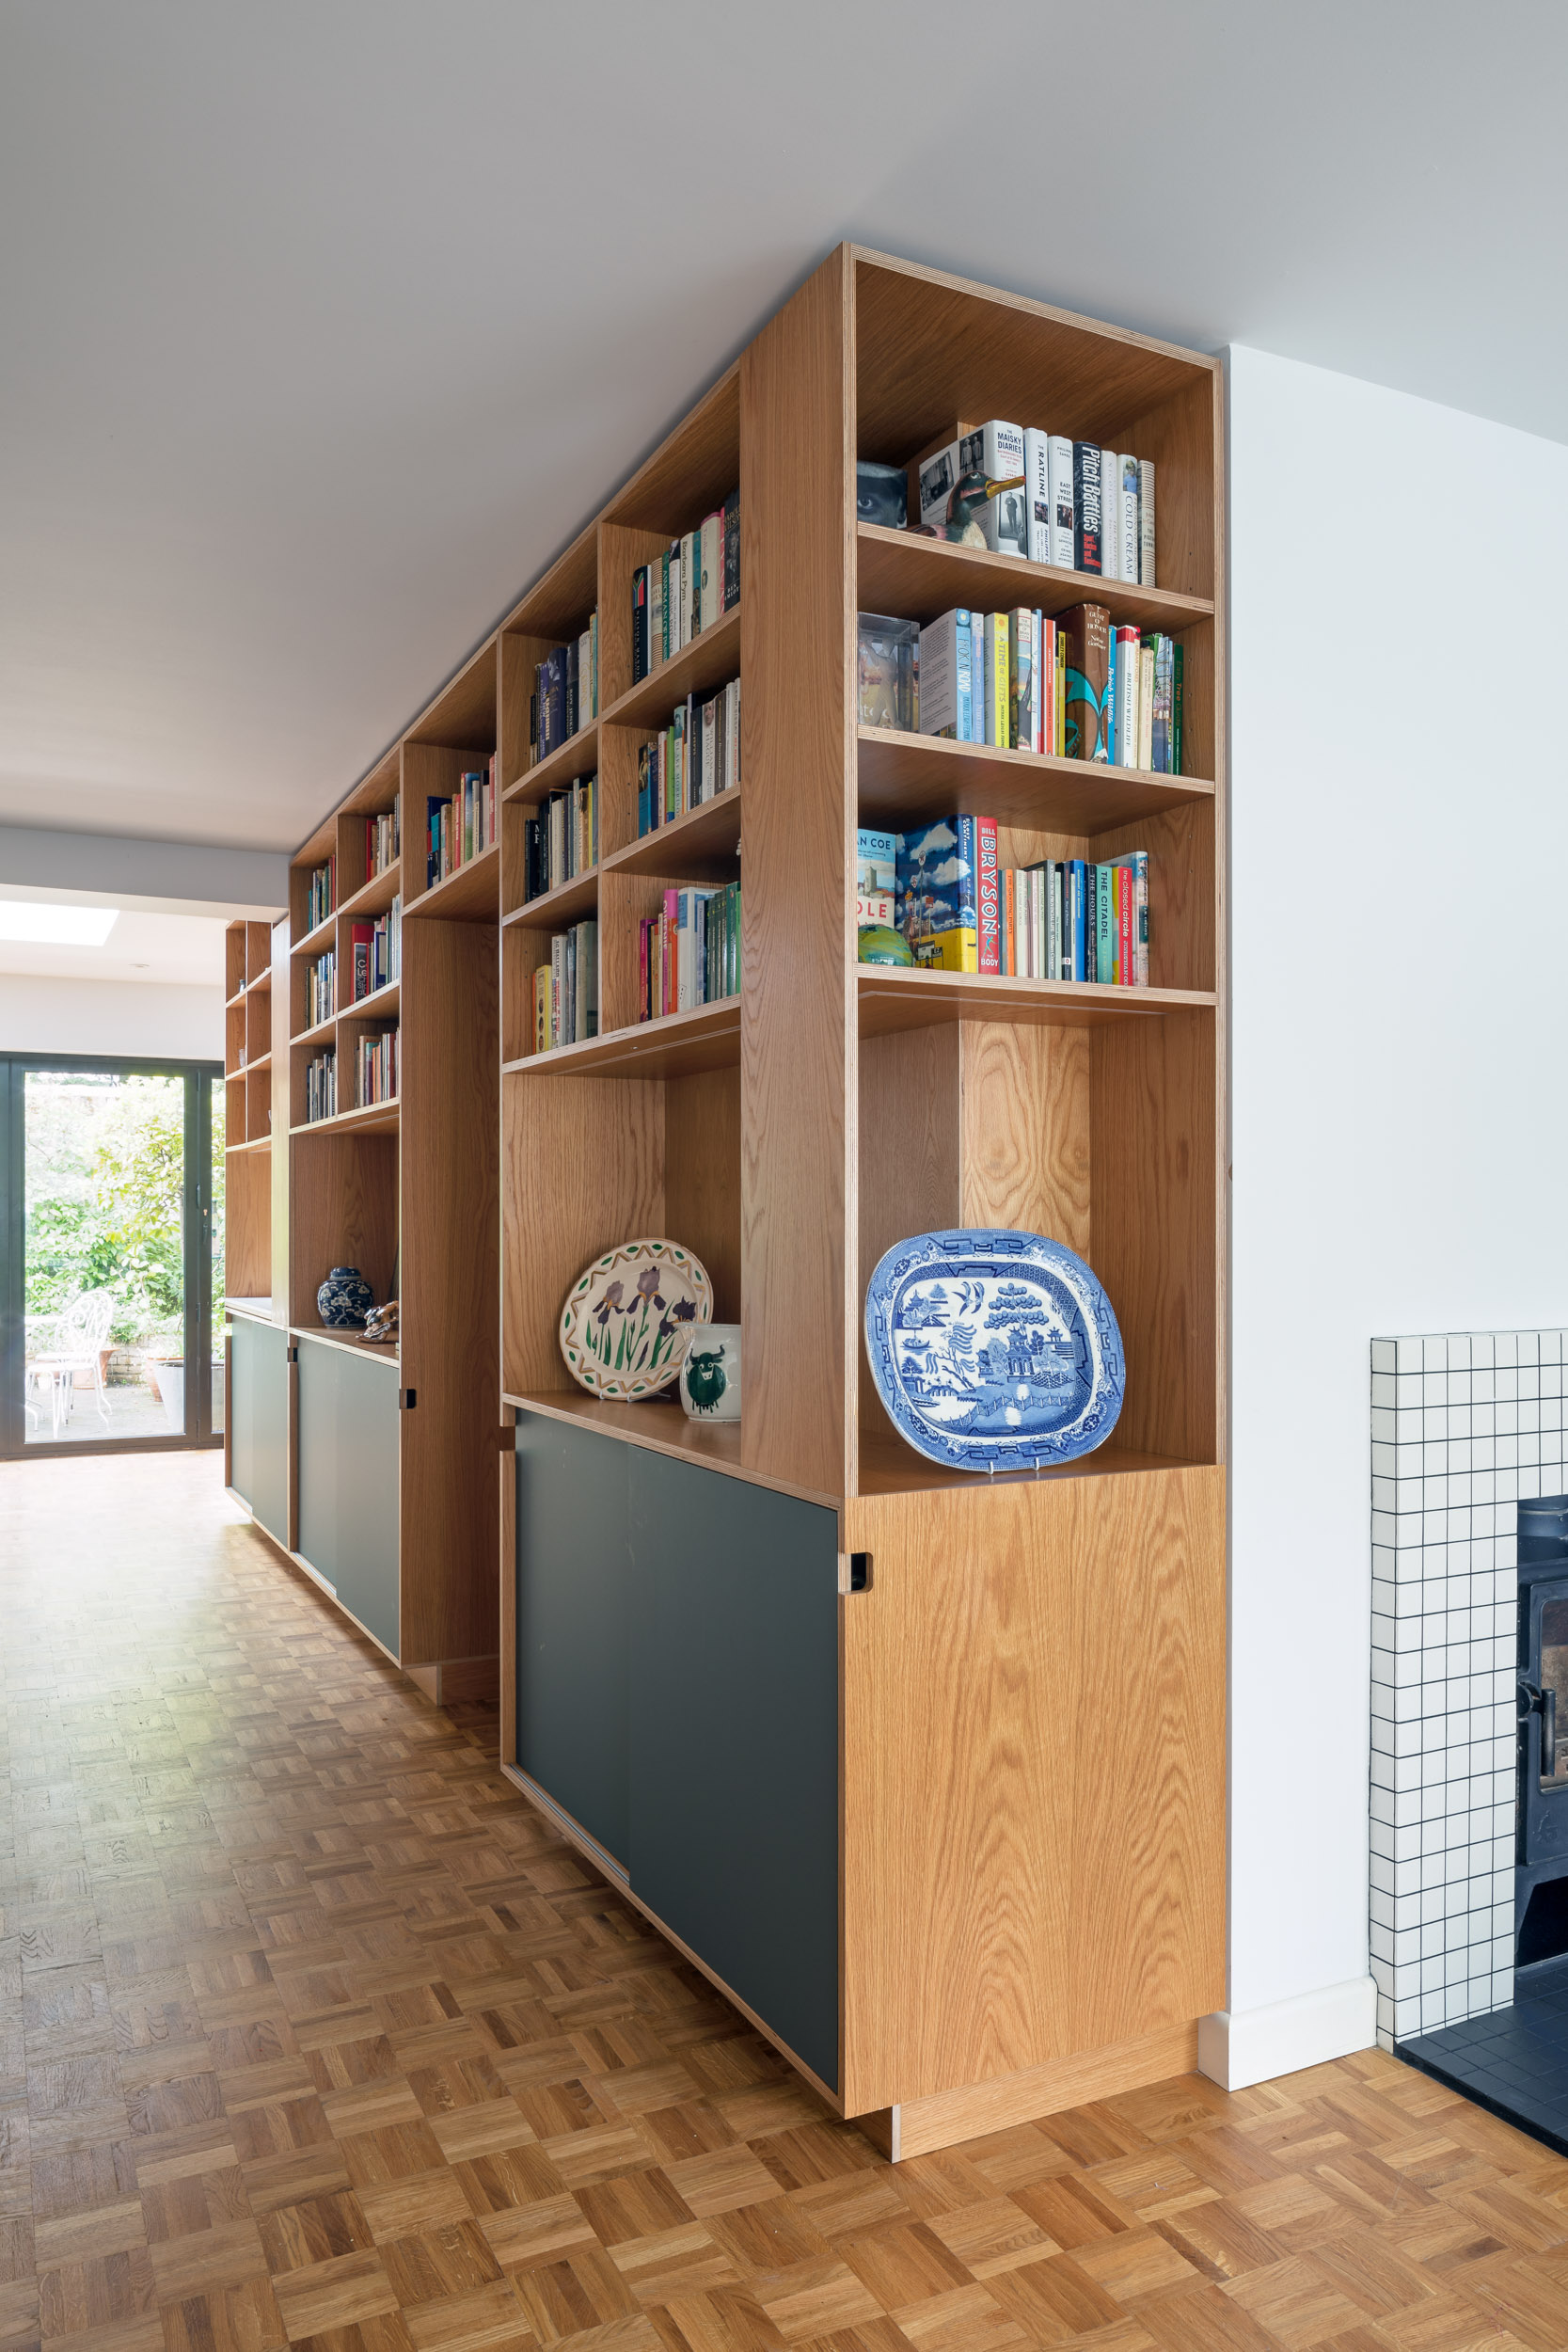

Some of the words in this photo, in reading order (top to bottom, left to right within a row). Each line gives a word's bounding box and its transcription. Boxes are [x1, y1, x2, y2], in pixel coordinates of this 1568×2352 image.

[997, 432, 1022, 445] MAISKY
[997, 441, 1022, 454] DIARIES
[1082, 446, 1100, 482] Pitch
[1057, 495, 1072, 504] STREET
[1083, 484, 1100, 533] Battles
[663, 621, 668, 633] OF
[958, 670, 970, 692] ROAD
[981, 827, 995, 836] BILL
[871, 838, 890, 850] COE
[981, 836, 997, 935] BRYSON
[981, 958, 999, 967] BODY
